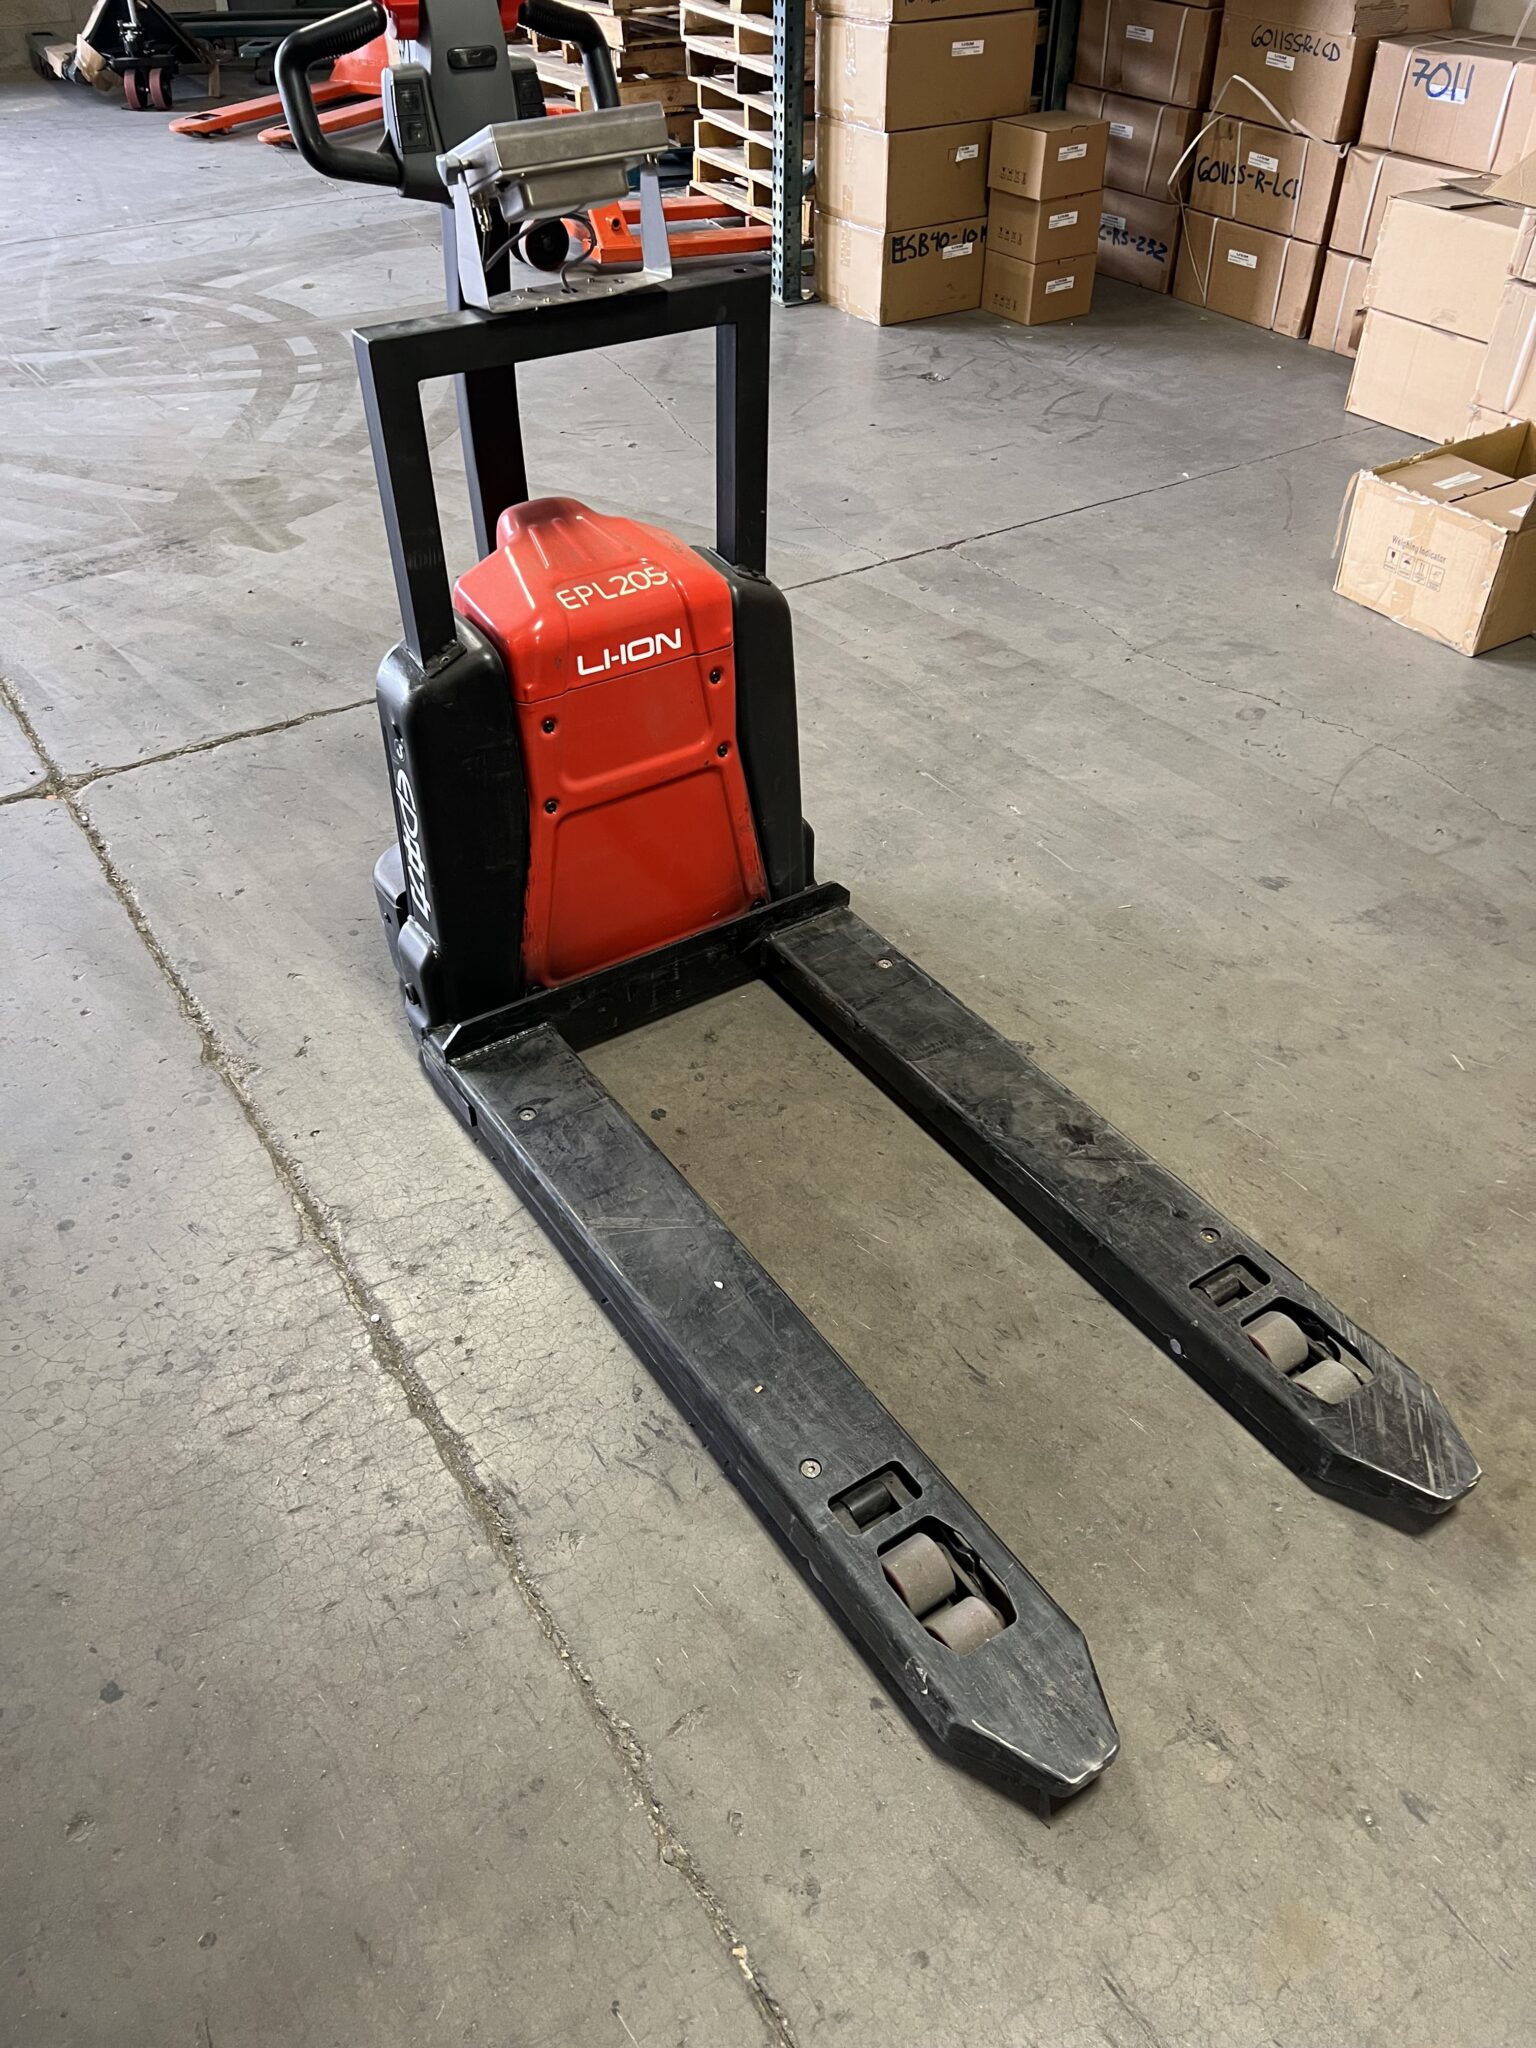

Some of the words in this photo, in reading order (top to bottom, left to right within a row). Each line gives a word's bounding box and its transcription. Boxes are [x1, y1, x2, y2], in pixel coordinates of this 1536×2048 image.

[1412, 58, 1475, 101] 7011
[1392, 535, 1420, 555] Weighing
[1419, 546, 1447, 564] Indicator
[556, 566, 669, 610] EPL205
[577, 628, 682, 676] LI-ION
